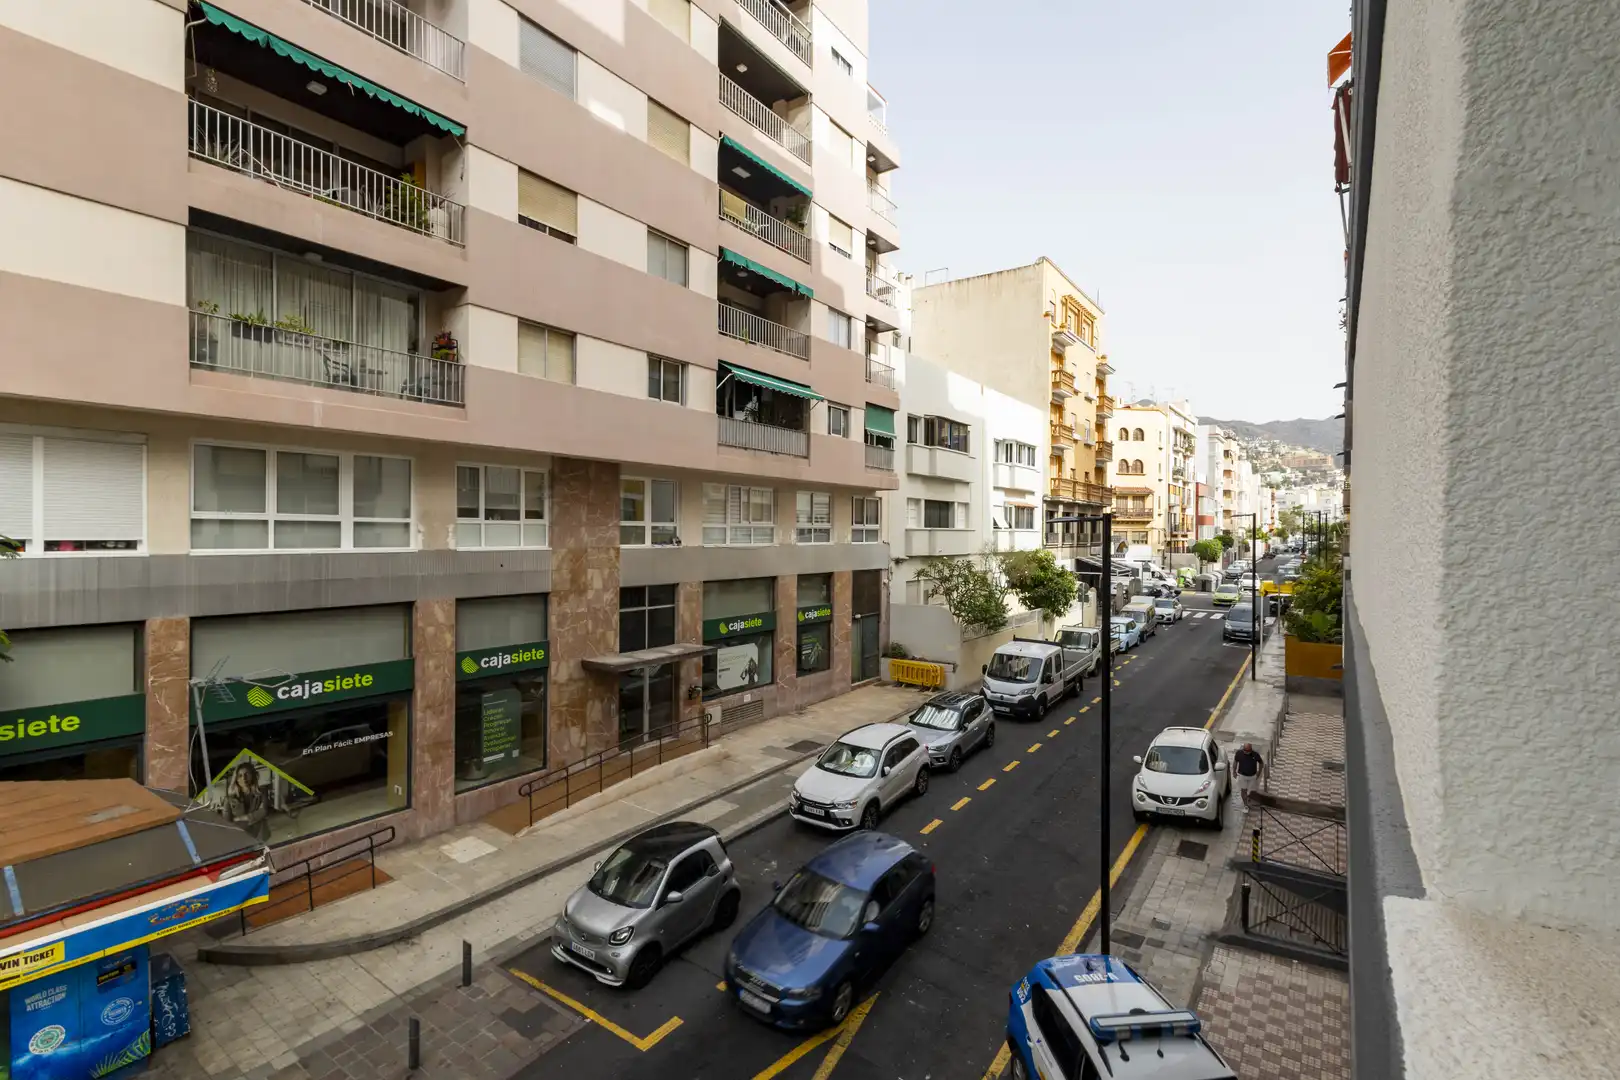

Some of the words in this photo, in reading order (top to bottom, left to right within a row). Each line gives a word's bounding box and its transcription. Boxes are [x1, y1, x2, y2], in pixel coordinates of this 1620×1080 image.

[804, 608, 832, 619] cajasiete
[728, 617, 763, 632] cajasiete
[480, 648, 545, 669] cajasiete
[277, 673, 374, 700] cajasiete
[0, 714, 81, 741] siete
[302, 747, 313, 756] En
[315, 744, 332, 753] Plan
[354, 731, 394, 744] EMPRESAS
[22, 948, 56, 966] TICKET
[25, 991, 47, 1005] WORLD
[48, 985, 68, 998] CLASS
[26, 991, 67, 1012] ATTRACTION
